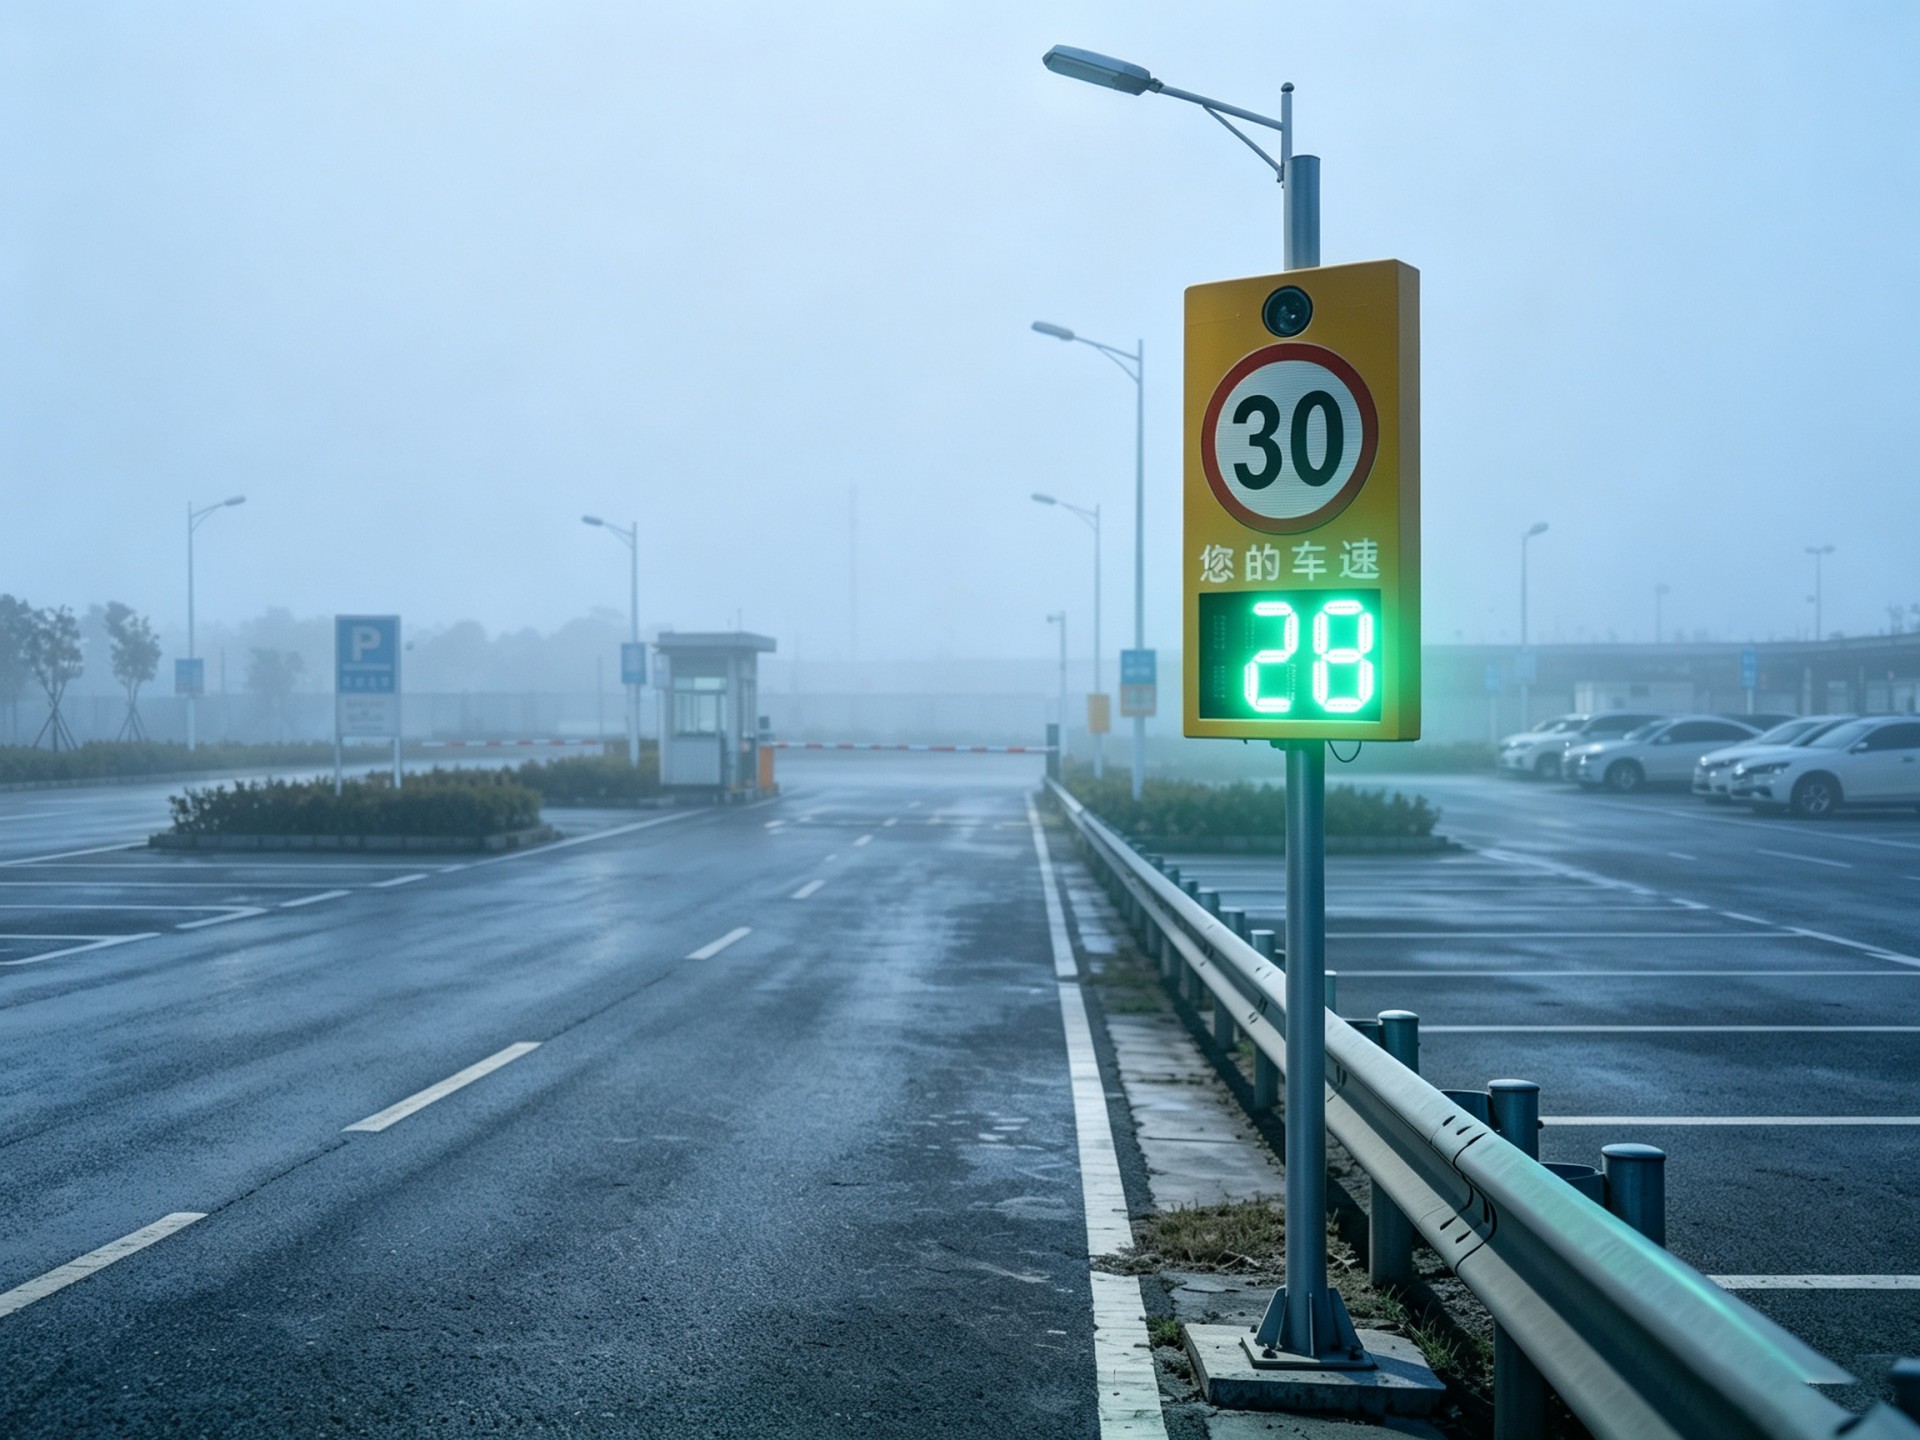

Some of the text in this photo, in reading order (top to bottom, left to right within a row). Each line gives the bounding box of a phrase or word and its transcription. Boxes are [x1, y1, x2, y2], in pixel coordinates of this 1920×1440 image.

[1233, 390, 1344, 490] 30
[1199, 538, 1380, 583] 您的车速
[352, 626, 381, 660] P
[1243, 600, 1374, 713] 28
